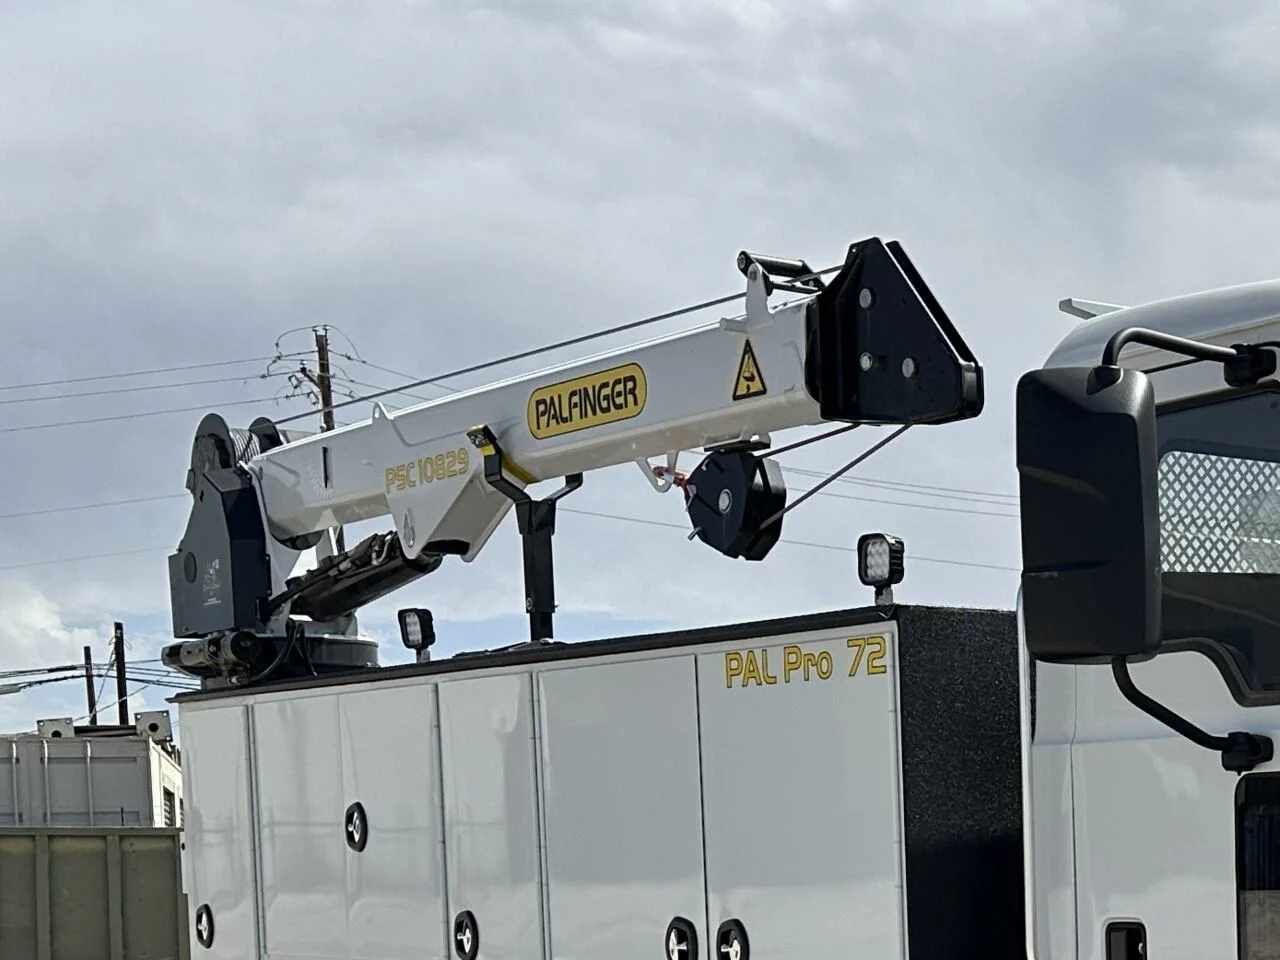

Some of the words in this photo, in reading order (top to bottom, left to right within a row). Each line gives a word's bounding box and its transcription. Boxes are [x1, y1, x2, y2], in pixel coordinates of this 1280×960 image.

[535, 374, 639, 430] PALFINGER
[385, 462, 417, 494] PSC
[417, 447, 470, 486] 10829
[725, 649, 777, 688] PAL
[784, 645, 833, 683] Pro
[847, 635, 887, 677] 72
